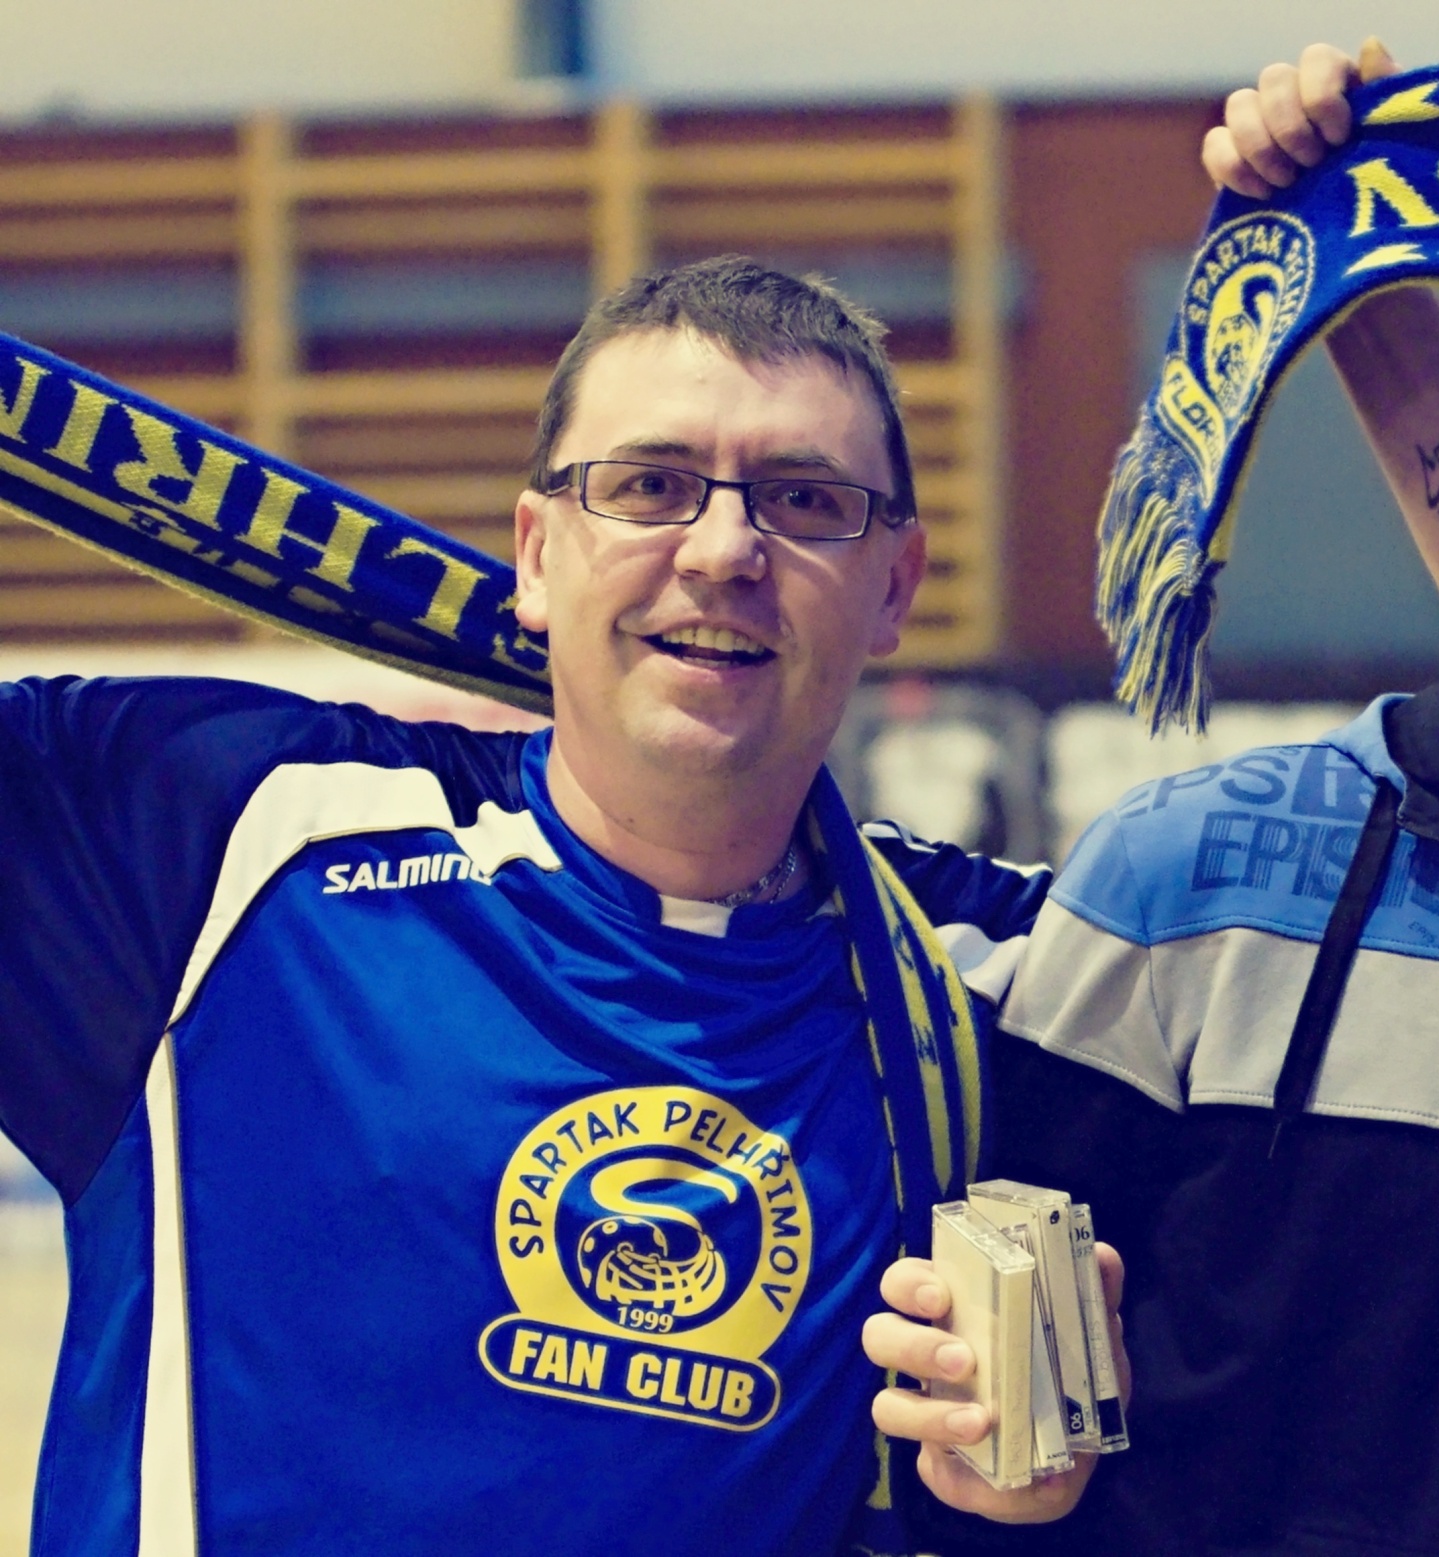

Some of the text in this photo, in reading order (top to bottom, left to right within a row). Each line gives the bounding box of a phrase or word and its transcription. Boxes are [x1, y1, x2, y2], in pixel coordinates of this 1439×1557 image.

[1188, 224, 1285, 325] SPARTAK
[0, 356, 552, 684] LHŘI
[508, 1100, 802, 1314] SPARTAK PELHŘIMOV
[616, 1306, 675, 1334] 1999
[508, 1328, 756, 1418] FAN CLUB
